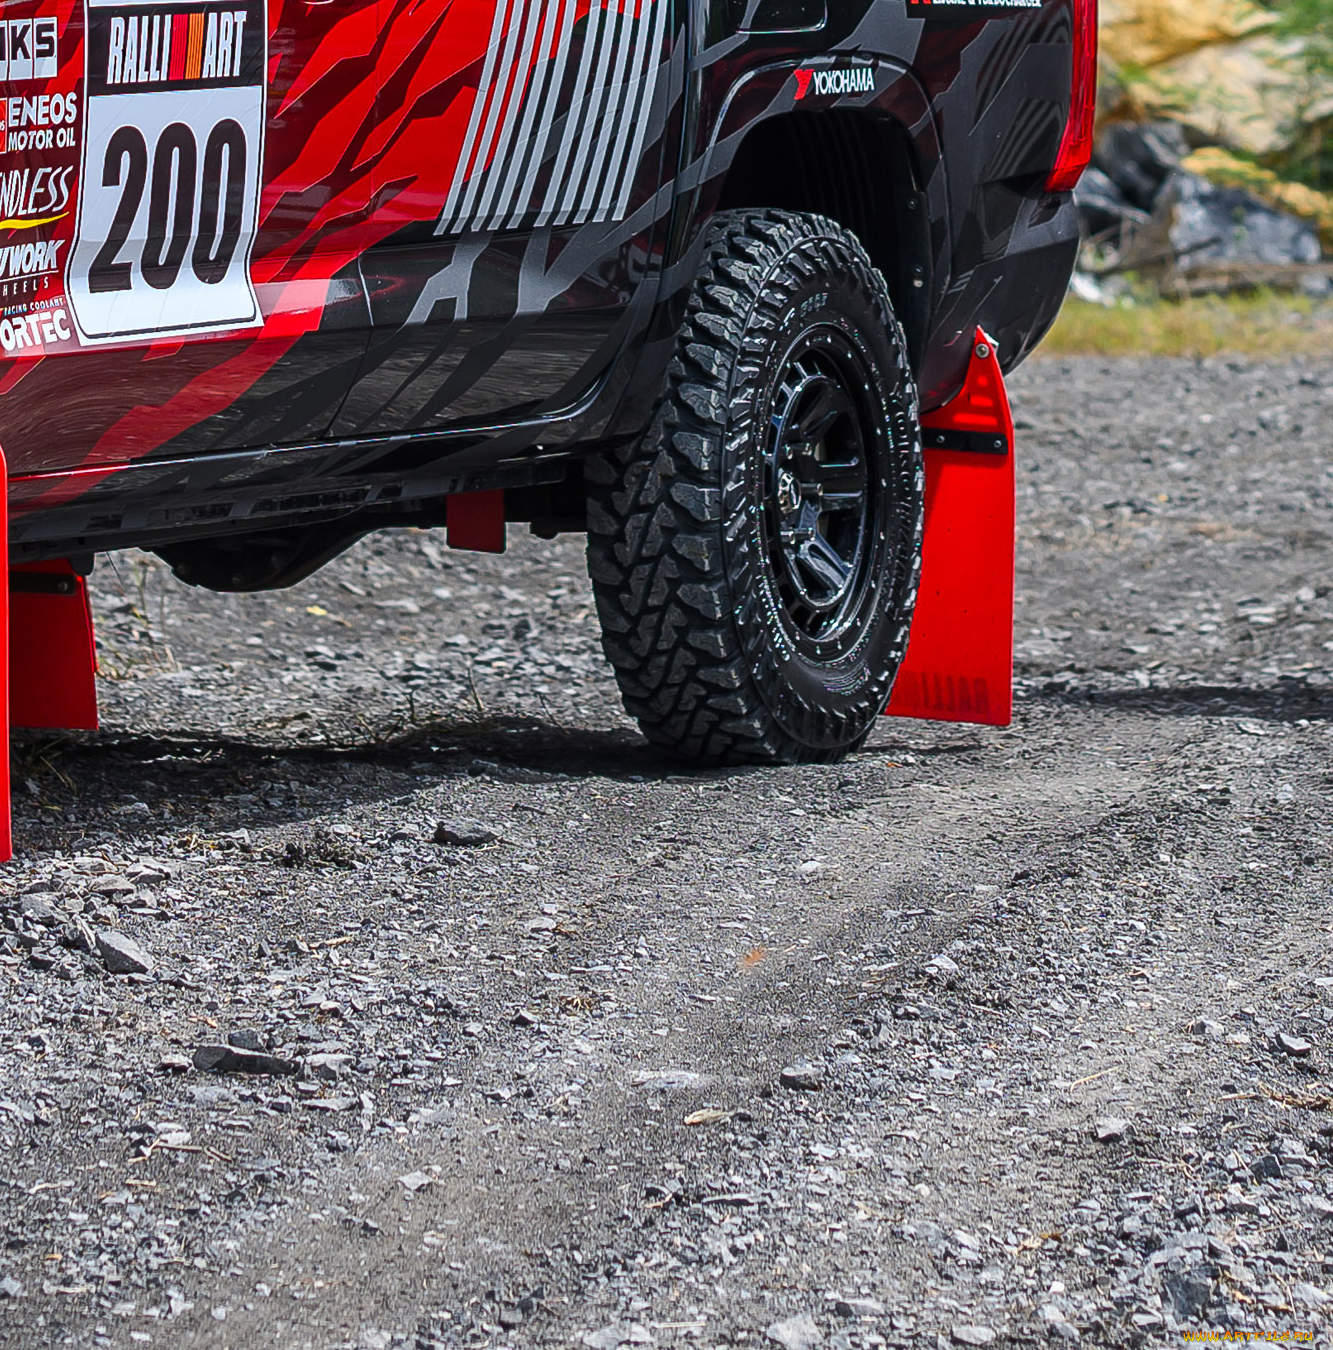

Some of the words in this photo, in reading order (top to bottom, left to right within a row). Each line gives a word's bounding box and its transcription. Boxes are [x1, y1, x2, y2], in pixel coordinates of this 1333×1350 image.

[813, 67, 875, 96] YOKOHAMA
[8, 92, 77, 127] ENEOS
[8, 129, 53, 152] MOTOR
[56, 126, 76, 148] OIL
[88, 118, 247, 295] 200
[4, 303, 27, 316] RACING
[30, 297, 64, 311] COOLANT
